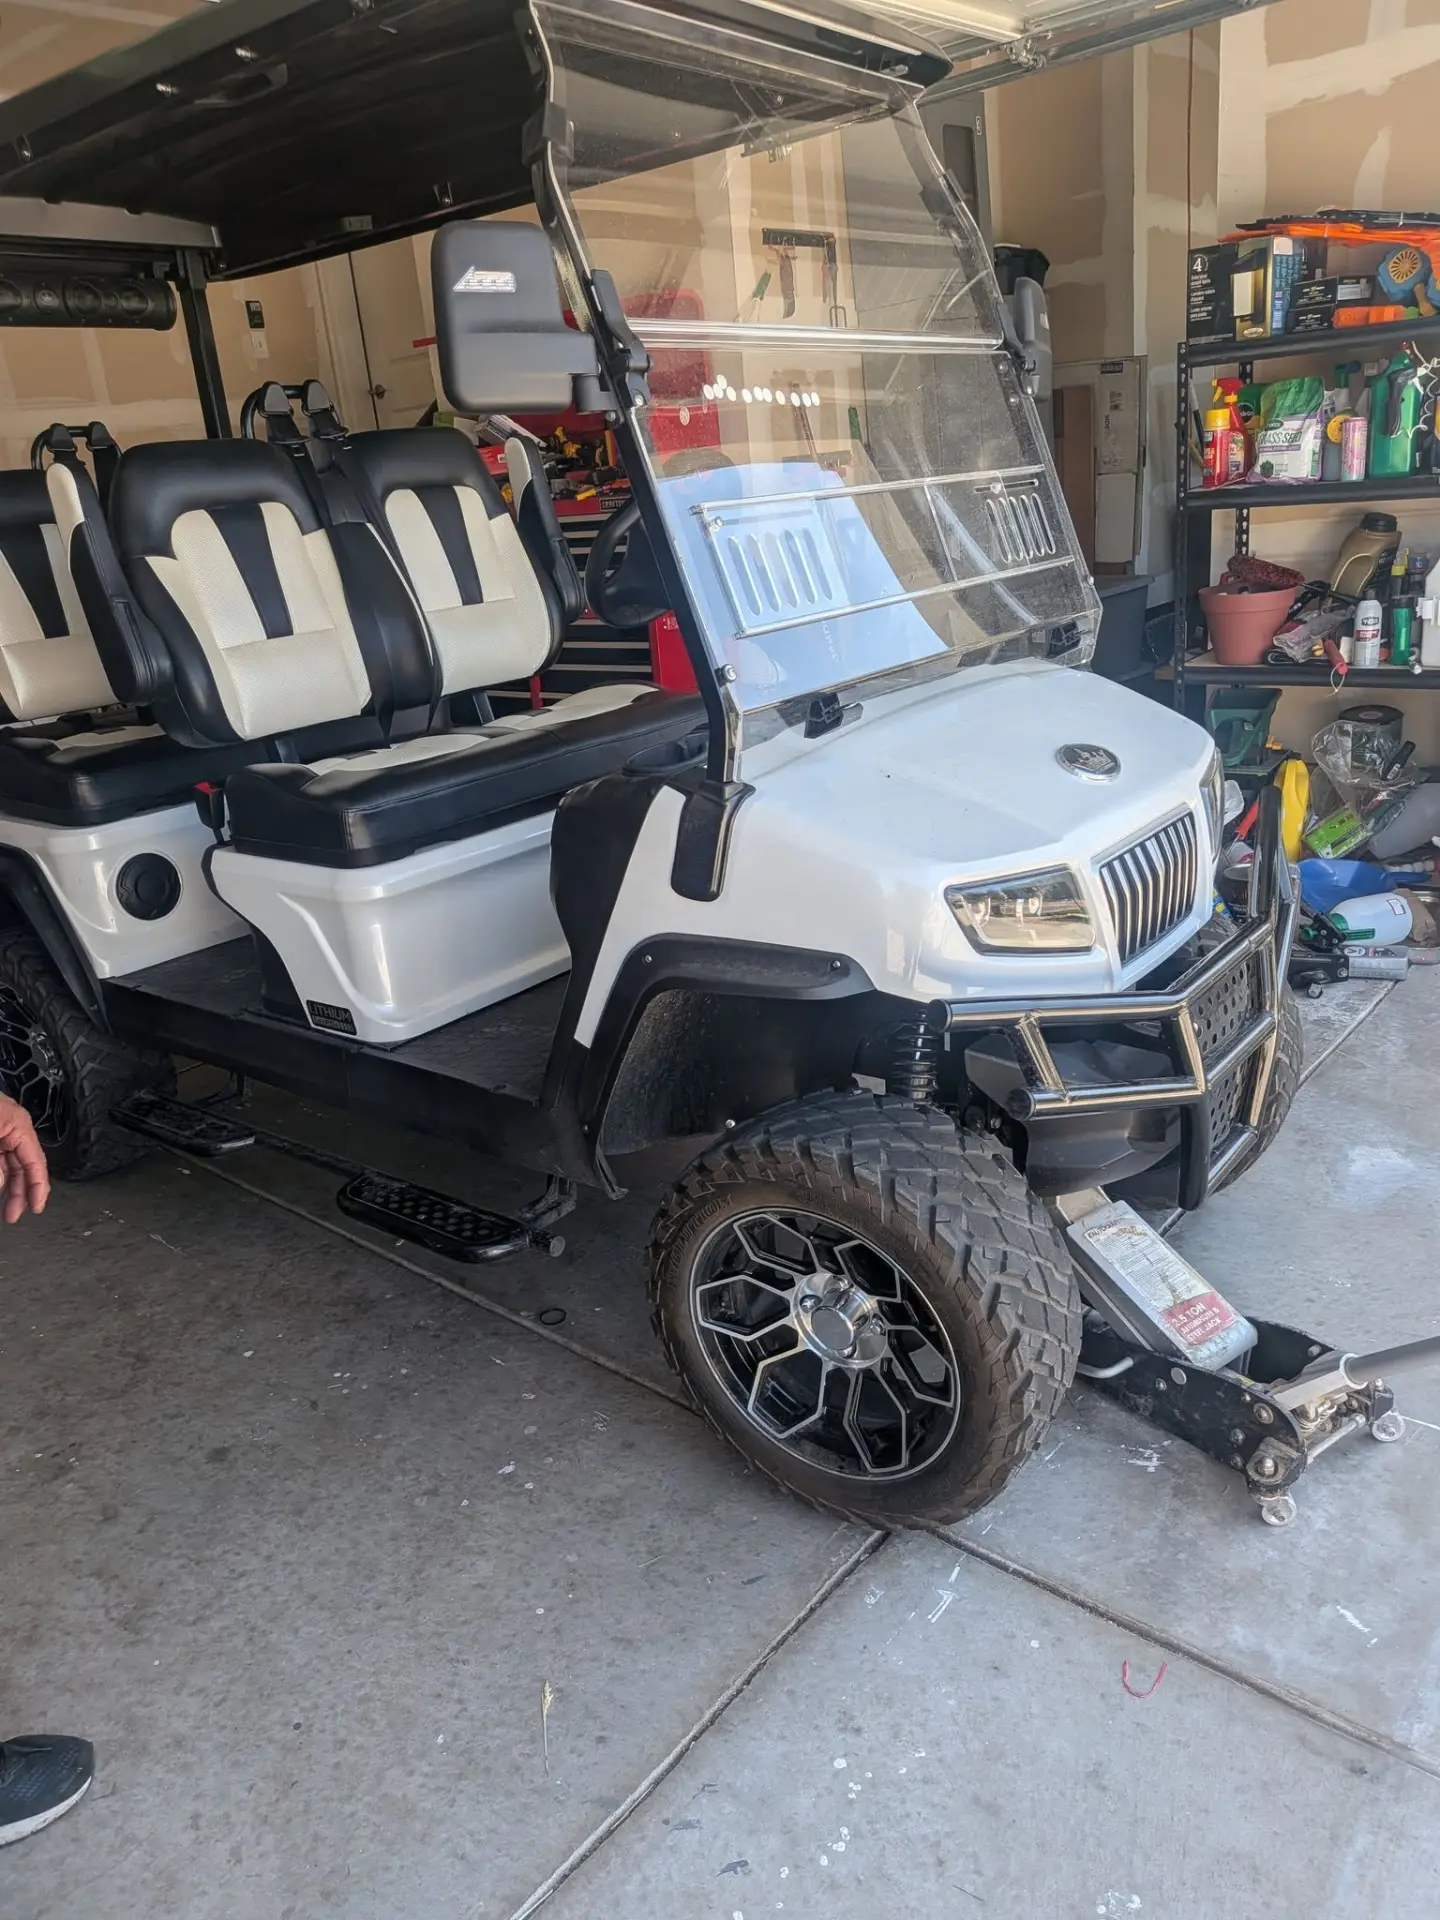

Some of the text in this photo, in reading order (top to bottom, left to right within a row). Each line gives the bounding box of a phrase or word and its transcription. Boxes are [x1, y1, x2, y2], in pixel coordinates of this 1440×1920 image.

[1192, 257, 1202, 272] 4
[308, 1004, 352, 1023] LITHIUM
[1172, 1302, 1207, 1327] 2.5 TON
[1186, 1316, 1222, 1341] STEEL JACK
